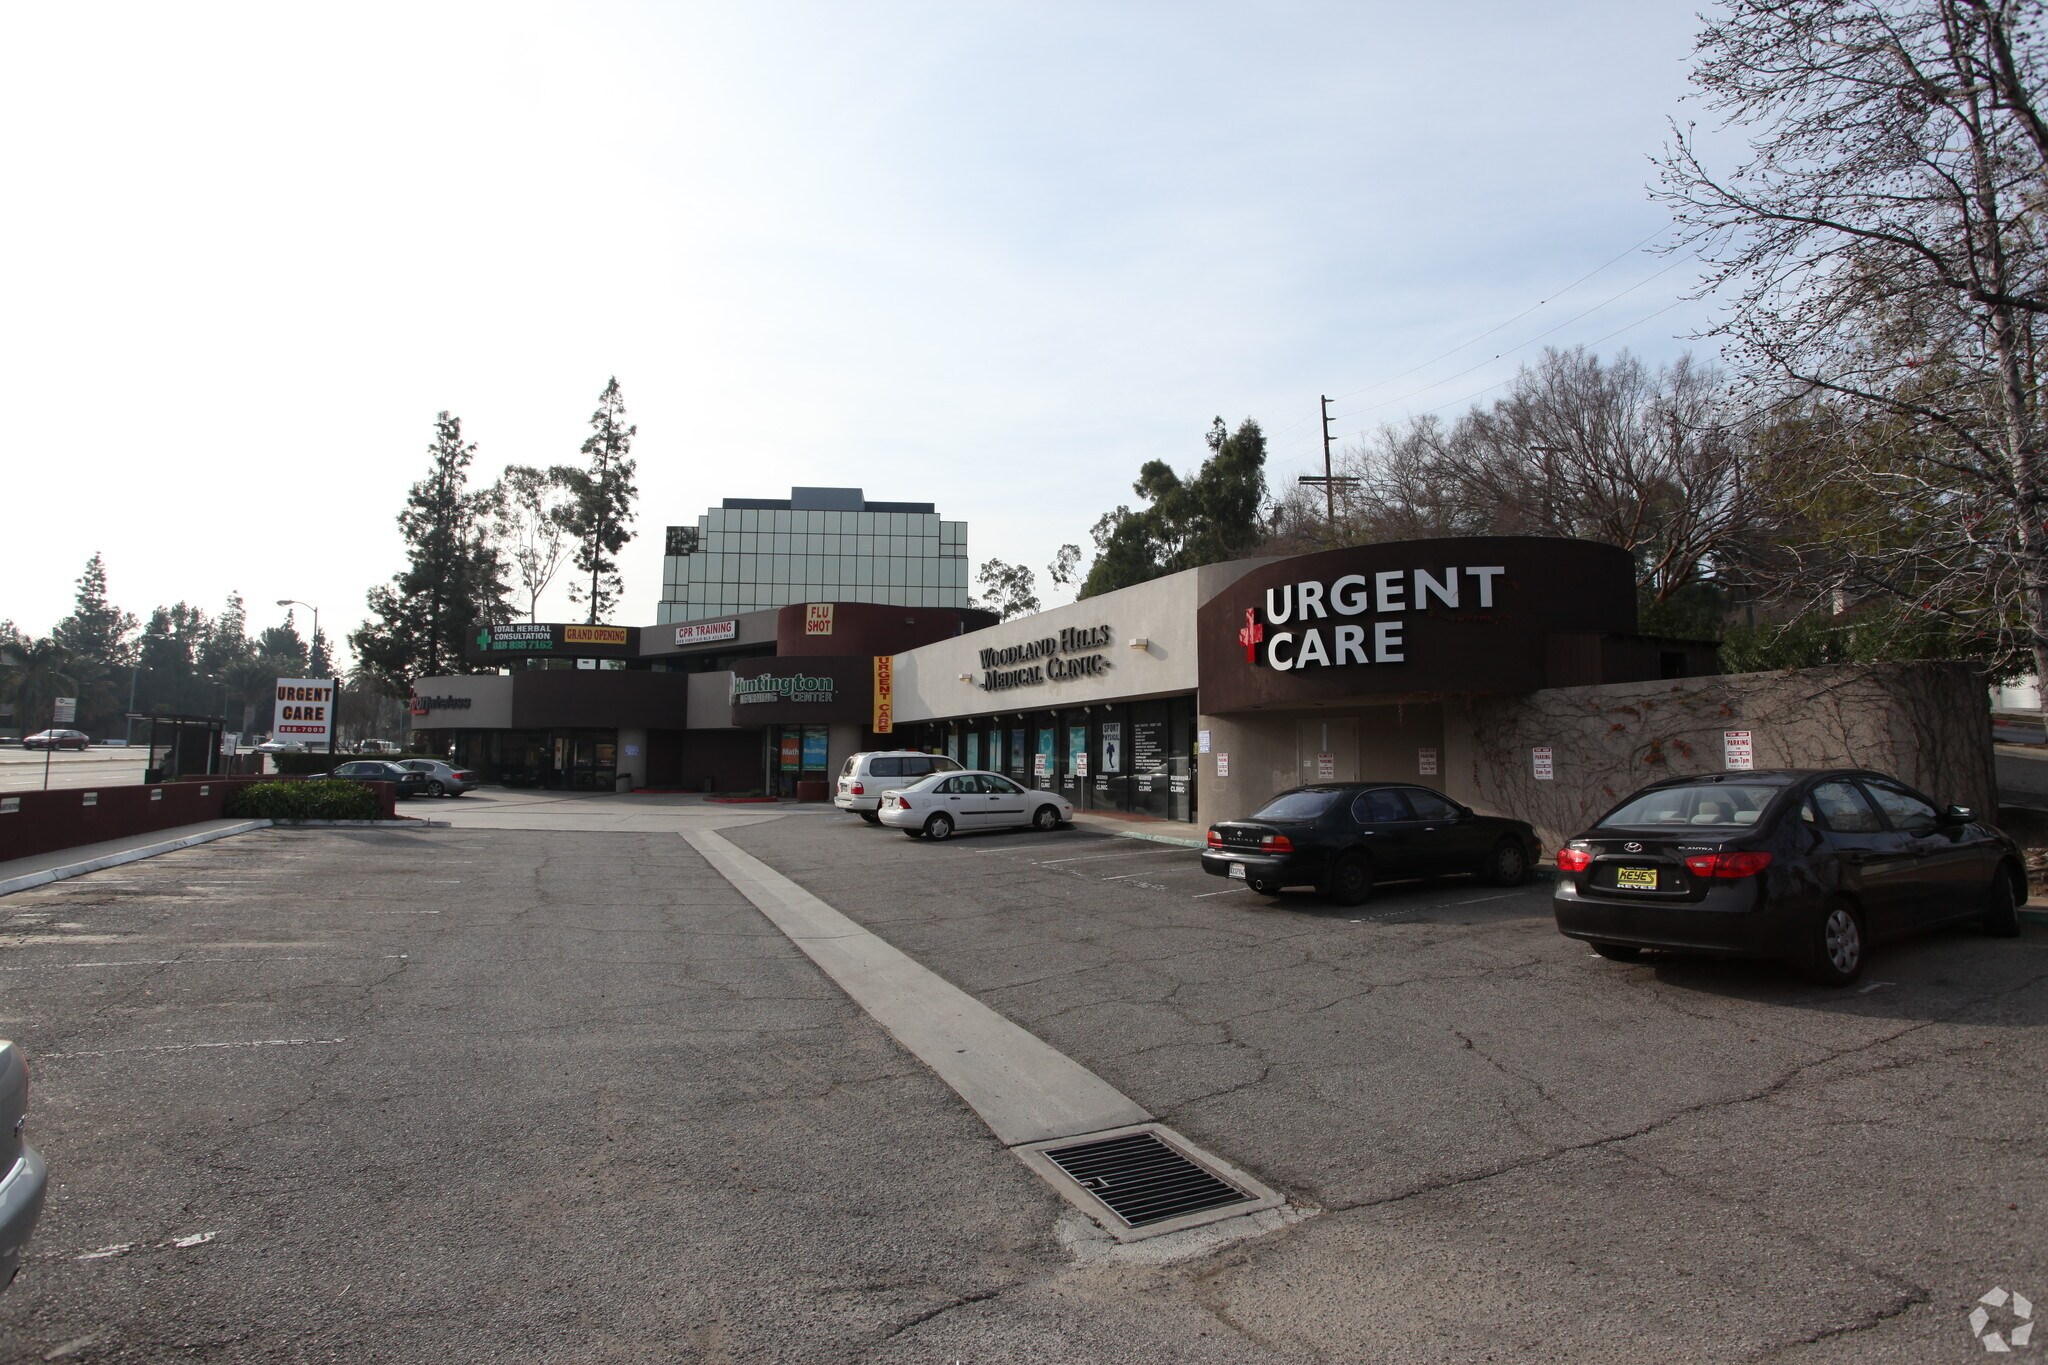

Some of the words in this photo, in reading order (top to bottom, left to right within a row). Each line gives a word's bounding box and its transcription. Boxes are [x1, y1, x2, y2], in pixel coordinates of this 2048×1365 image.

[1266, 565, 1505, 625] URGENT
[811, 606, 829, 619] FLU
[493, 625, 515, 633] TOTAL
[516, 625, 552, 633] HERBAL
[679, 627, 693, 638] CPR
[695, 622, 732, 636] TRAINING
[807, 619, 831, 632] SHOT
[494, 632, 551, 640] CONSULTATION
[566, 628, 593, 640] GRAND
[594, 629, 625, 642] OPENING
[528, 640, 553, 650] 7162
[978, 637, 1057, 670] WOODLAND
[1058, 625, 1110, 653] HILLS
[1268, 621, 1405, 671] CARE
[878, 656, 891, 700] URGENT
[984, 666, 1044, 691] MEDICAL
[1045, 654, 1103, 681] CLINIC
[735, 673, 833, 697] Huntington
[277, 686, 333, 702] URGENT
[791, 691, 833, 703] CENTER
[282, 705, 325, 721] CARE
[878, 704, 890, 733] CARE
[1103, 723, 1119, 733] SPORT
[782, 747, 799, 755] Math
[1620, 870, 1655, 884] KEYES
